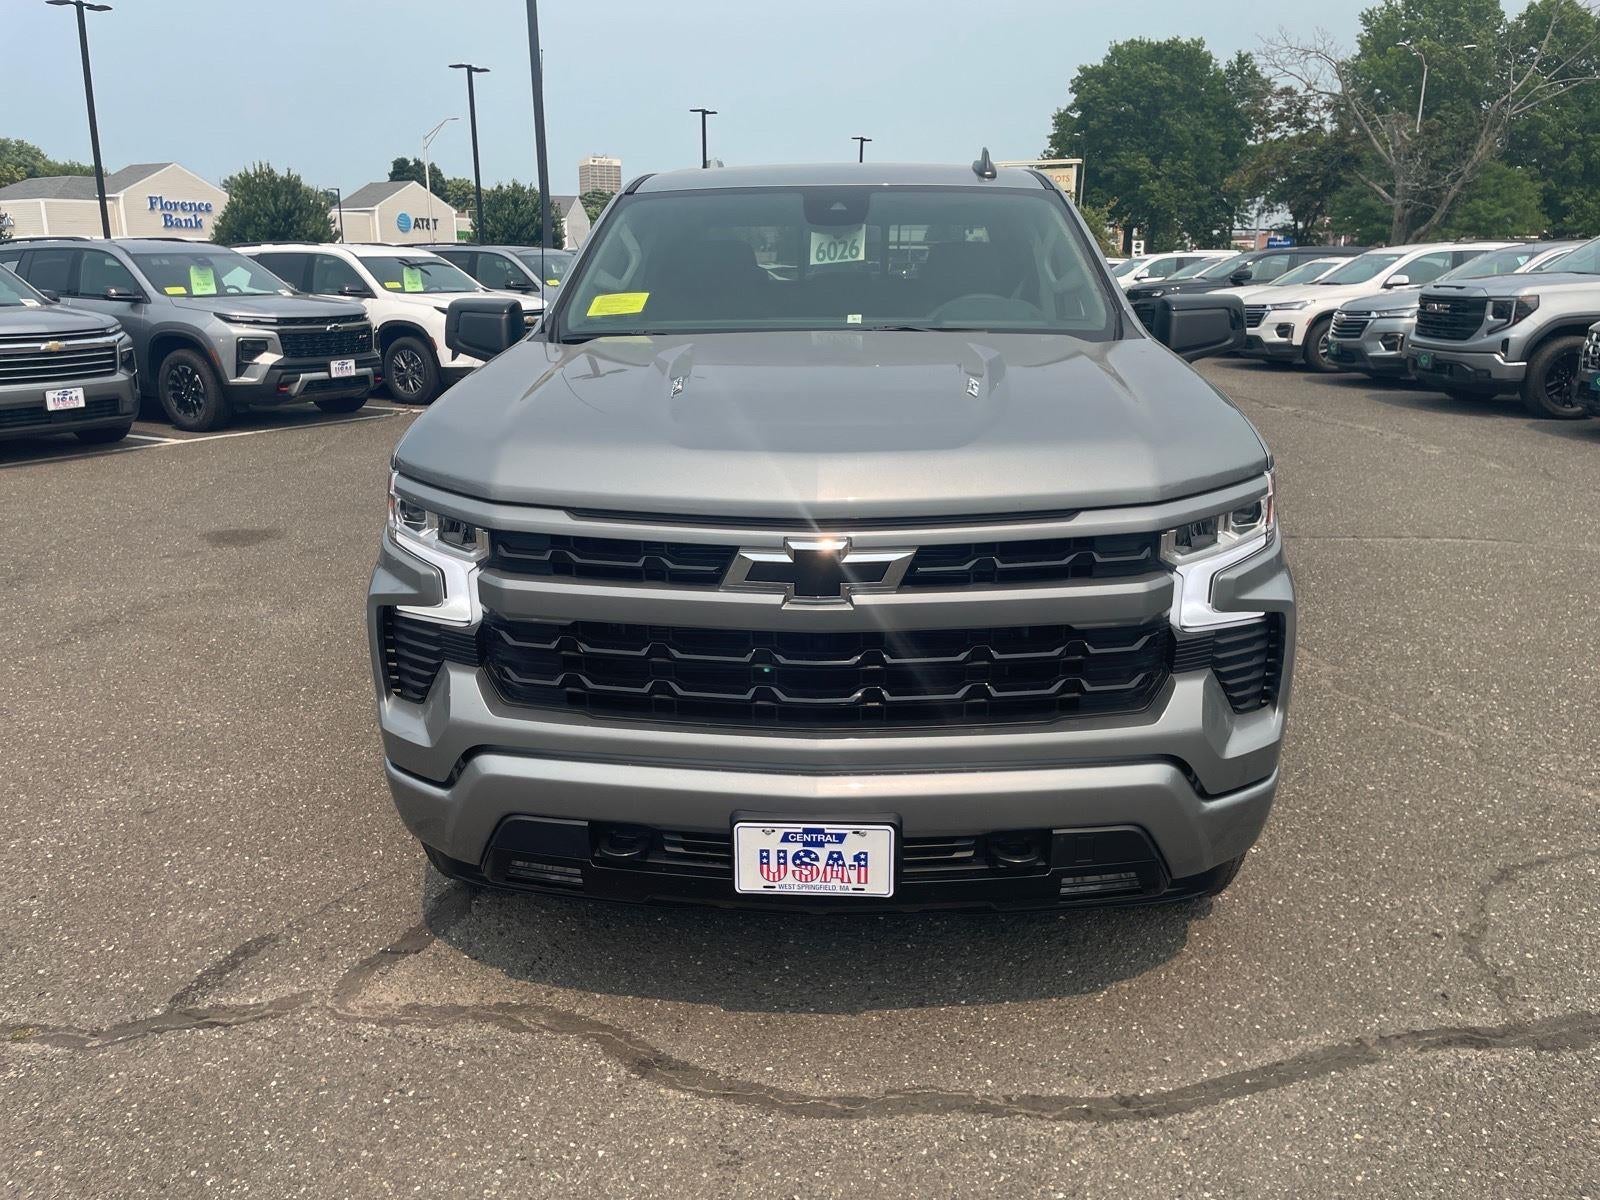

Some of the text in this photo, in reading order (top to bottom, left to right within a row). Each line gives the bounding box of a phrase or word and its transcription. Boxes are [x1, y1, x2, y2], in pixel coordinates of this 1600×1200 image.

[148, 196, 213, 212] Florence
[162, 213, 203, 229] Bank
[413, 217, 439, 230] AT&T
[815, 239, 860, 262] 6026
[788, 833, 839, 843] CENTRAL
